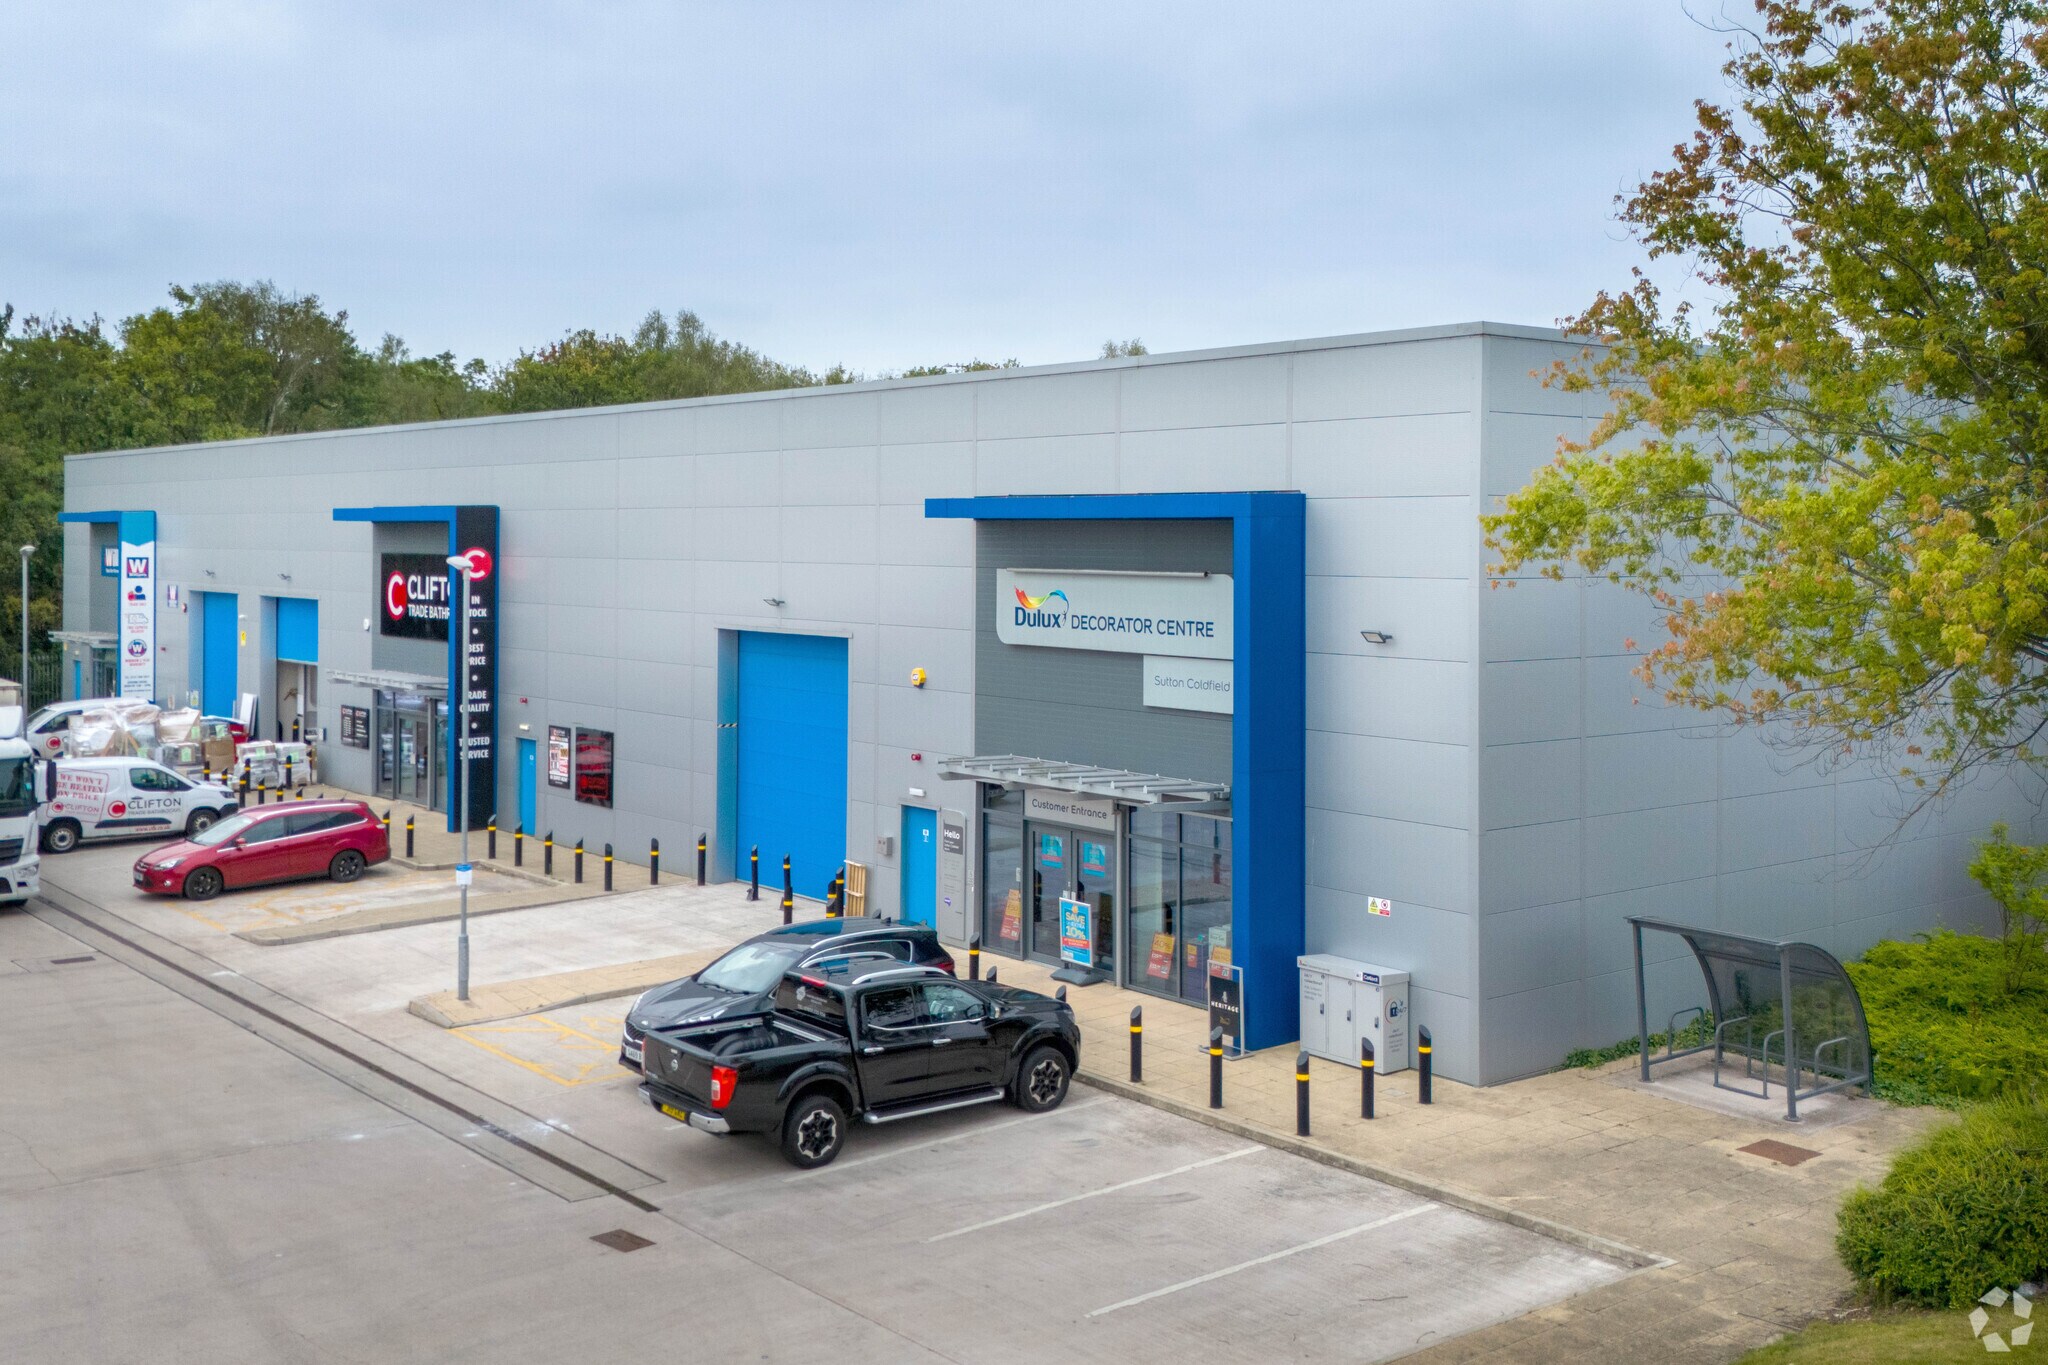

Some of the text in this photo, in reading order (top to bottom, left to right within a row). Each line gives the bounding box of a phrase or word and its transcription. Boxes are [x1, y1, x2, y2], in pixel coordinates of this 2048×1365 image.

[128, 559, 147, 573] W
[387, 574, 404, 615] C
[471, 595, 480, 605] IN
[408, 604, 429, 618] TRADE
[469, 608, 487, 617] TOCK
[1014, 606, 1215, 638] Dulux DECORATOR CENTRE
[469, 656, 486, 666] RICE
[1154, 675, 1231, 692] Sutton Coldfield
[468, 690, 487, 700] RADE
[458, 736, 490, 747] TUSTED
[459, 749, 489, 760] SRVICE
[65, 803, 99, 812] CLIFTON
[128, 797, 181, 810] CLIFTON
[1032, 798, 1107, 819] Customer Entrance
[944, 829, 960, 839] Hello
[1065, 911, 1085, 925] SAVE
[1065, 925, 1086, 940] 10%
[1211, 1000, 1239, 1013] HERITAGE
